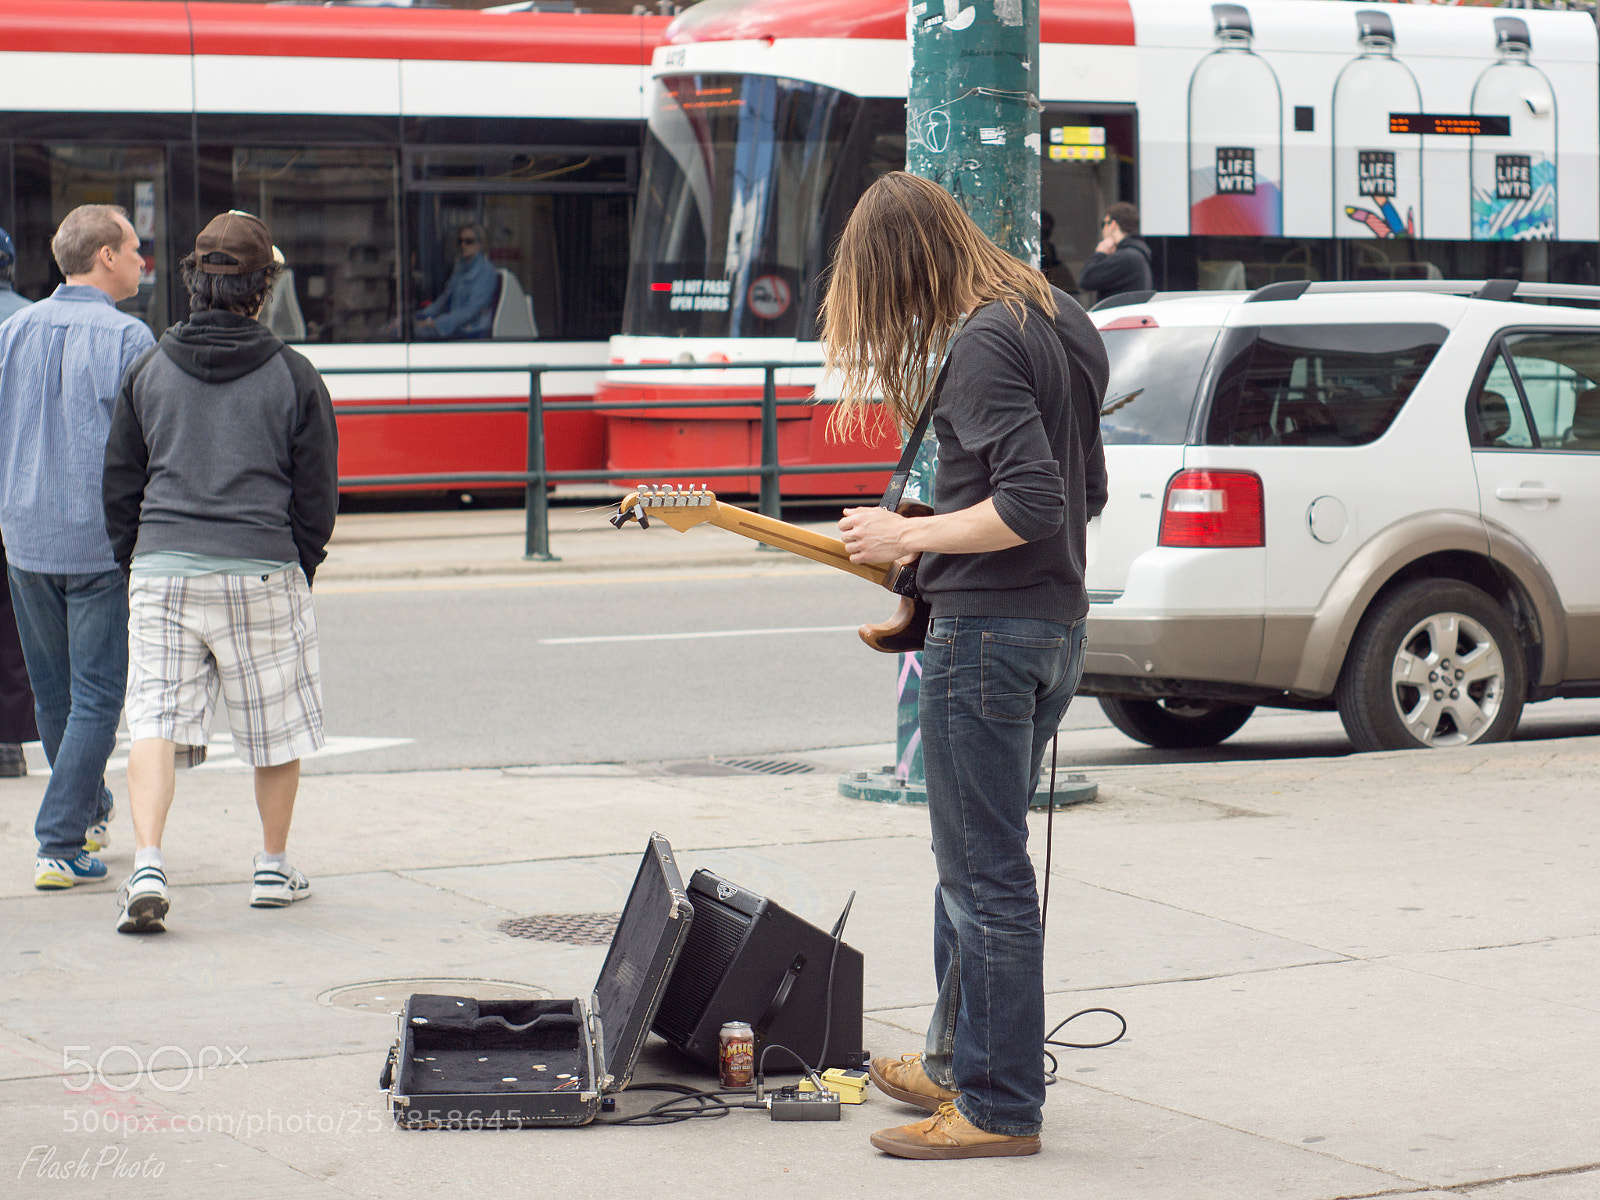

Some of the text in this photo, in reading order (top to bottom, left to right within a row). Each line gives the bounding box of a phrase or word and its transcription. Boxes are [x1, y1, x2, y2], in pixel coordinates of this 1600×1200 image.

[1218, 159, 1253, 174] LIFE
[1360, 163, 1394, 178] LIFE
[1497, 166, 1530, 181] LIFE
[1218, 175, 1254, 190] WTR
[1360, 178, 1395, 193] WTR
[1498, 181, 1530, 197] WTR
[684, 280, 702, 295] NOT
[702, 280, 731, 295] PASS
[670, 296, 729, 311] OPEN DOORS
[726, 1043, 753, 1059] MUG
